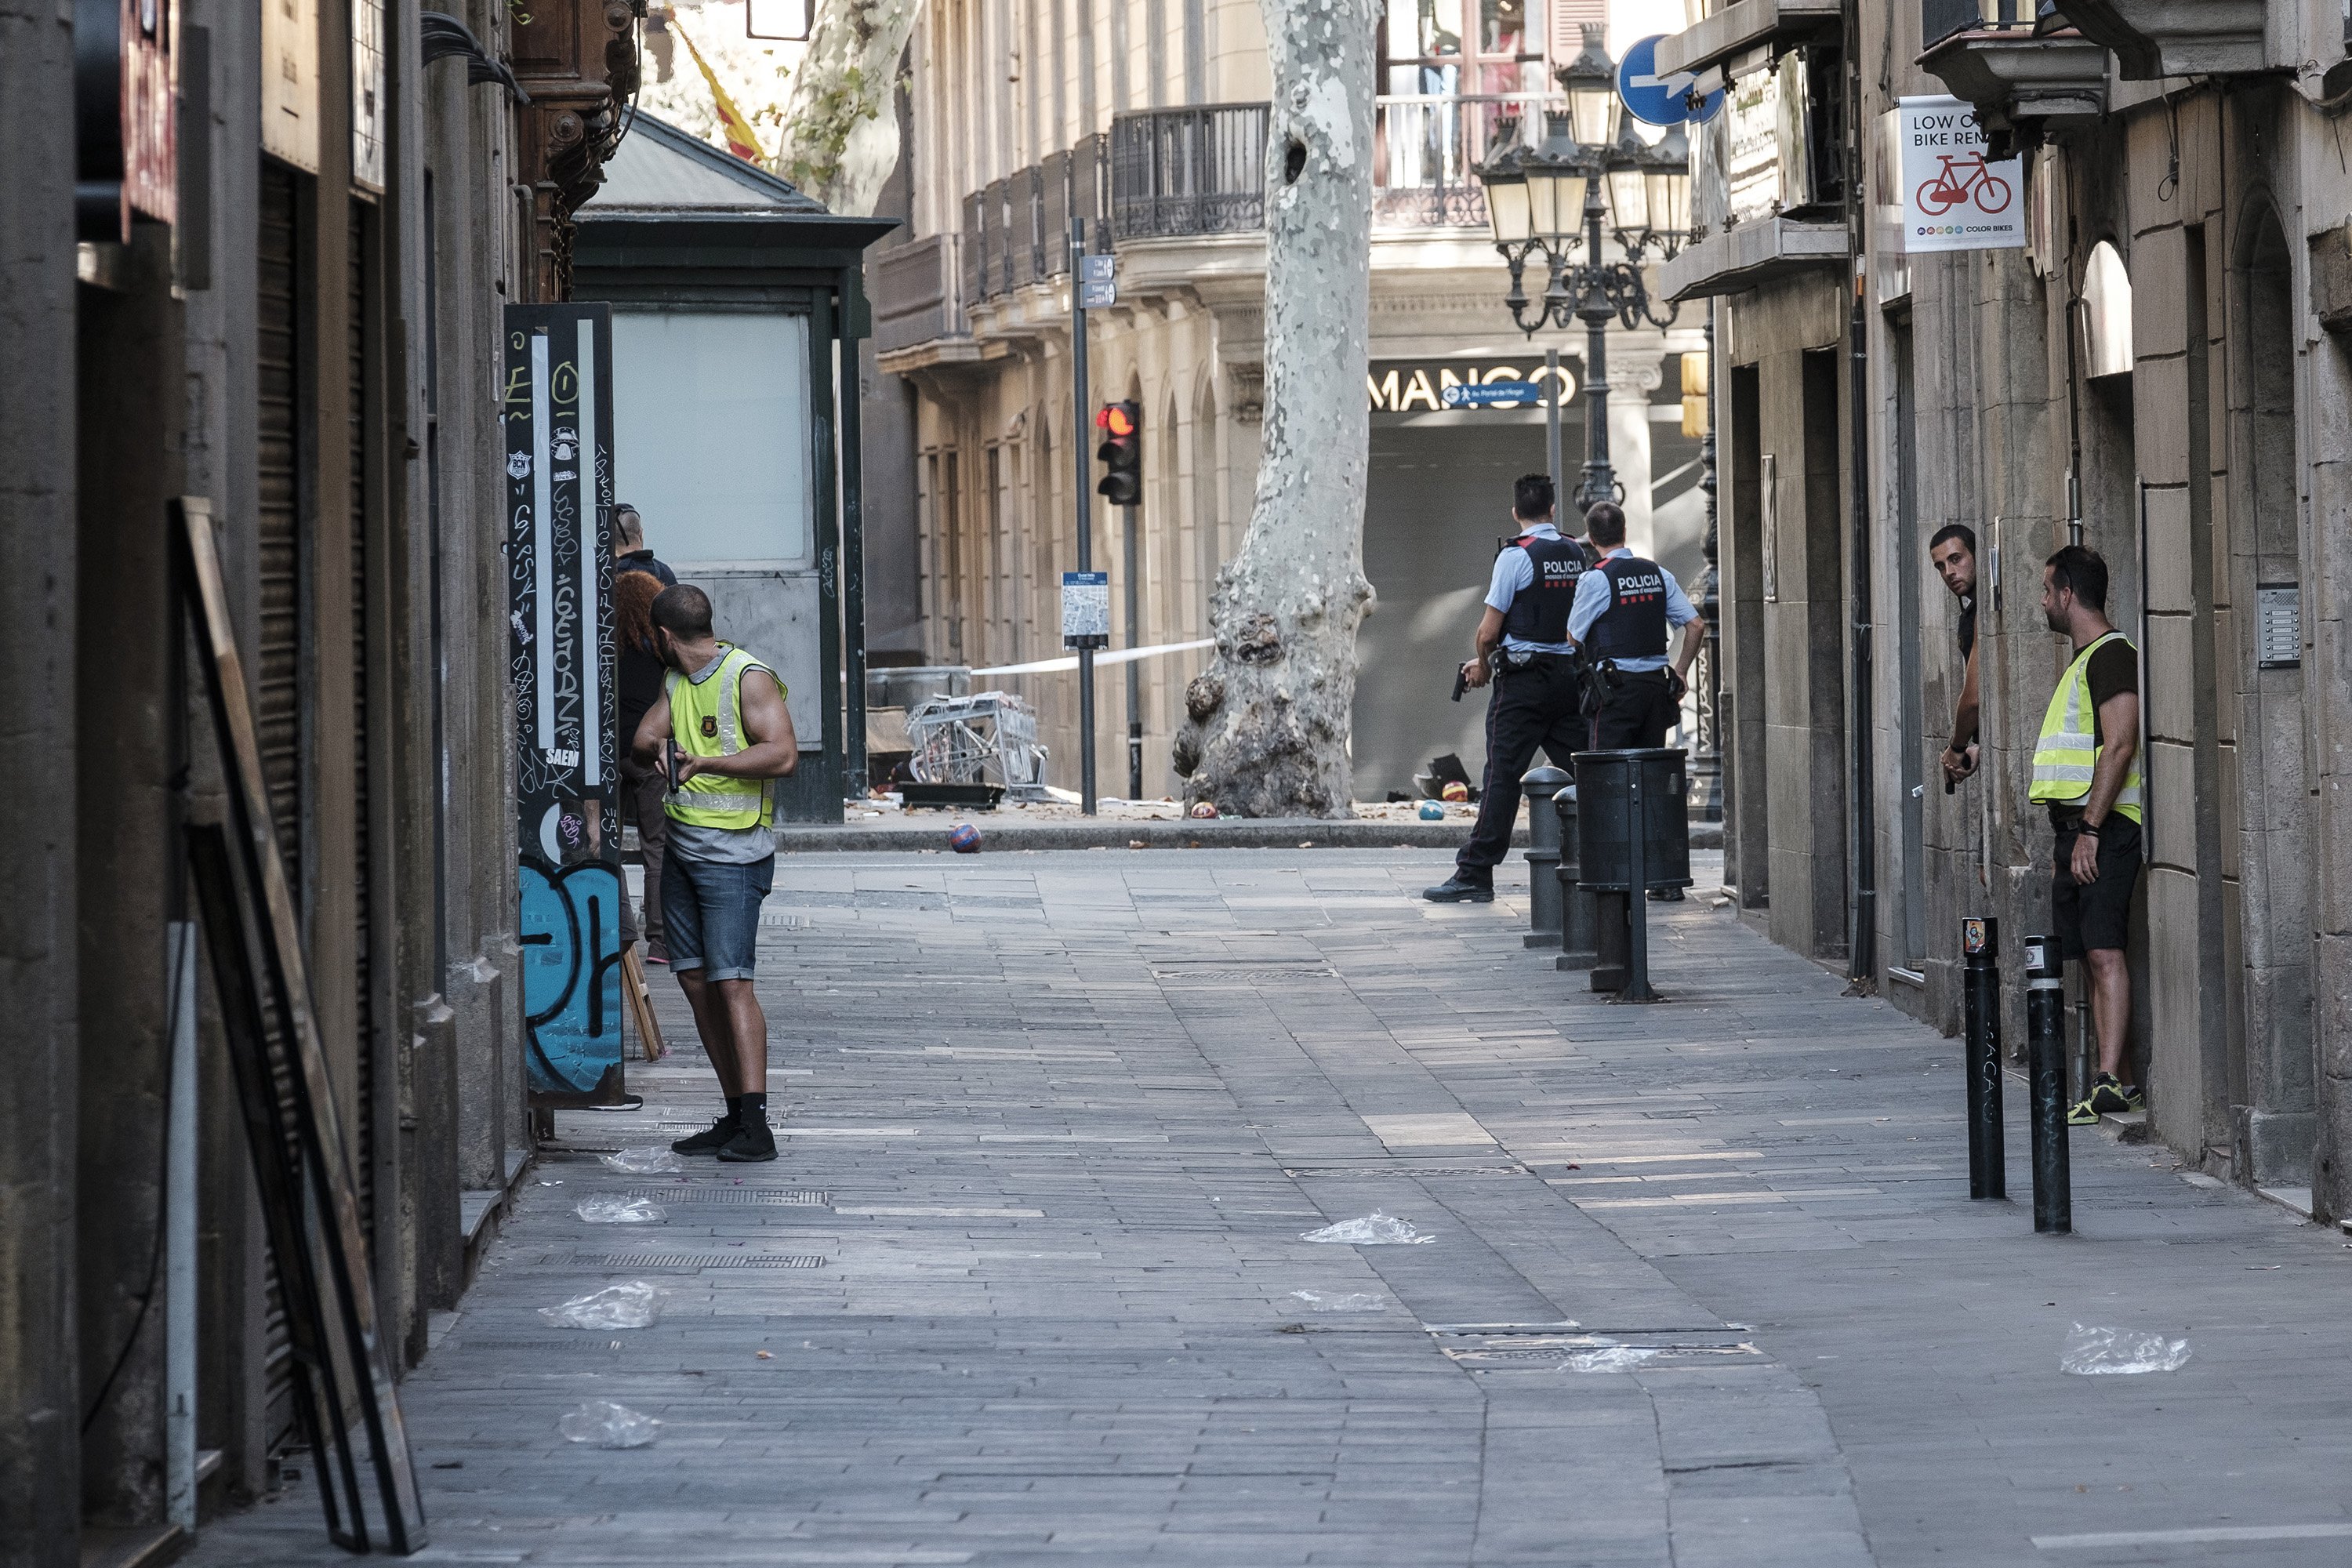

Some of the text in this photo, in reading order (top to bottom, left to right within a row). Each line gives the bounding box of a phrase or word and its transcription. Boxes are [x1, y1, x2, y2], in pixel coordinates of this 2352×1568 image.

[1914, 115, 1954, 129] LOW
[1915, 133, 1948, 146] BIKE
[513, 459, 526, 469] BCN
[1543, 560, 1583, 573] POLICIA
[1617, 574, 1662, 590] POLICIA
[546, 748, 579, 768] SAEM
